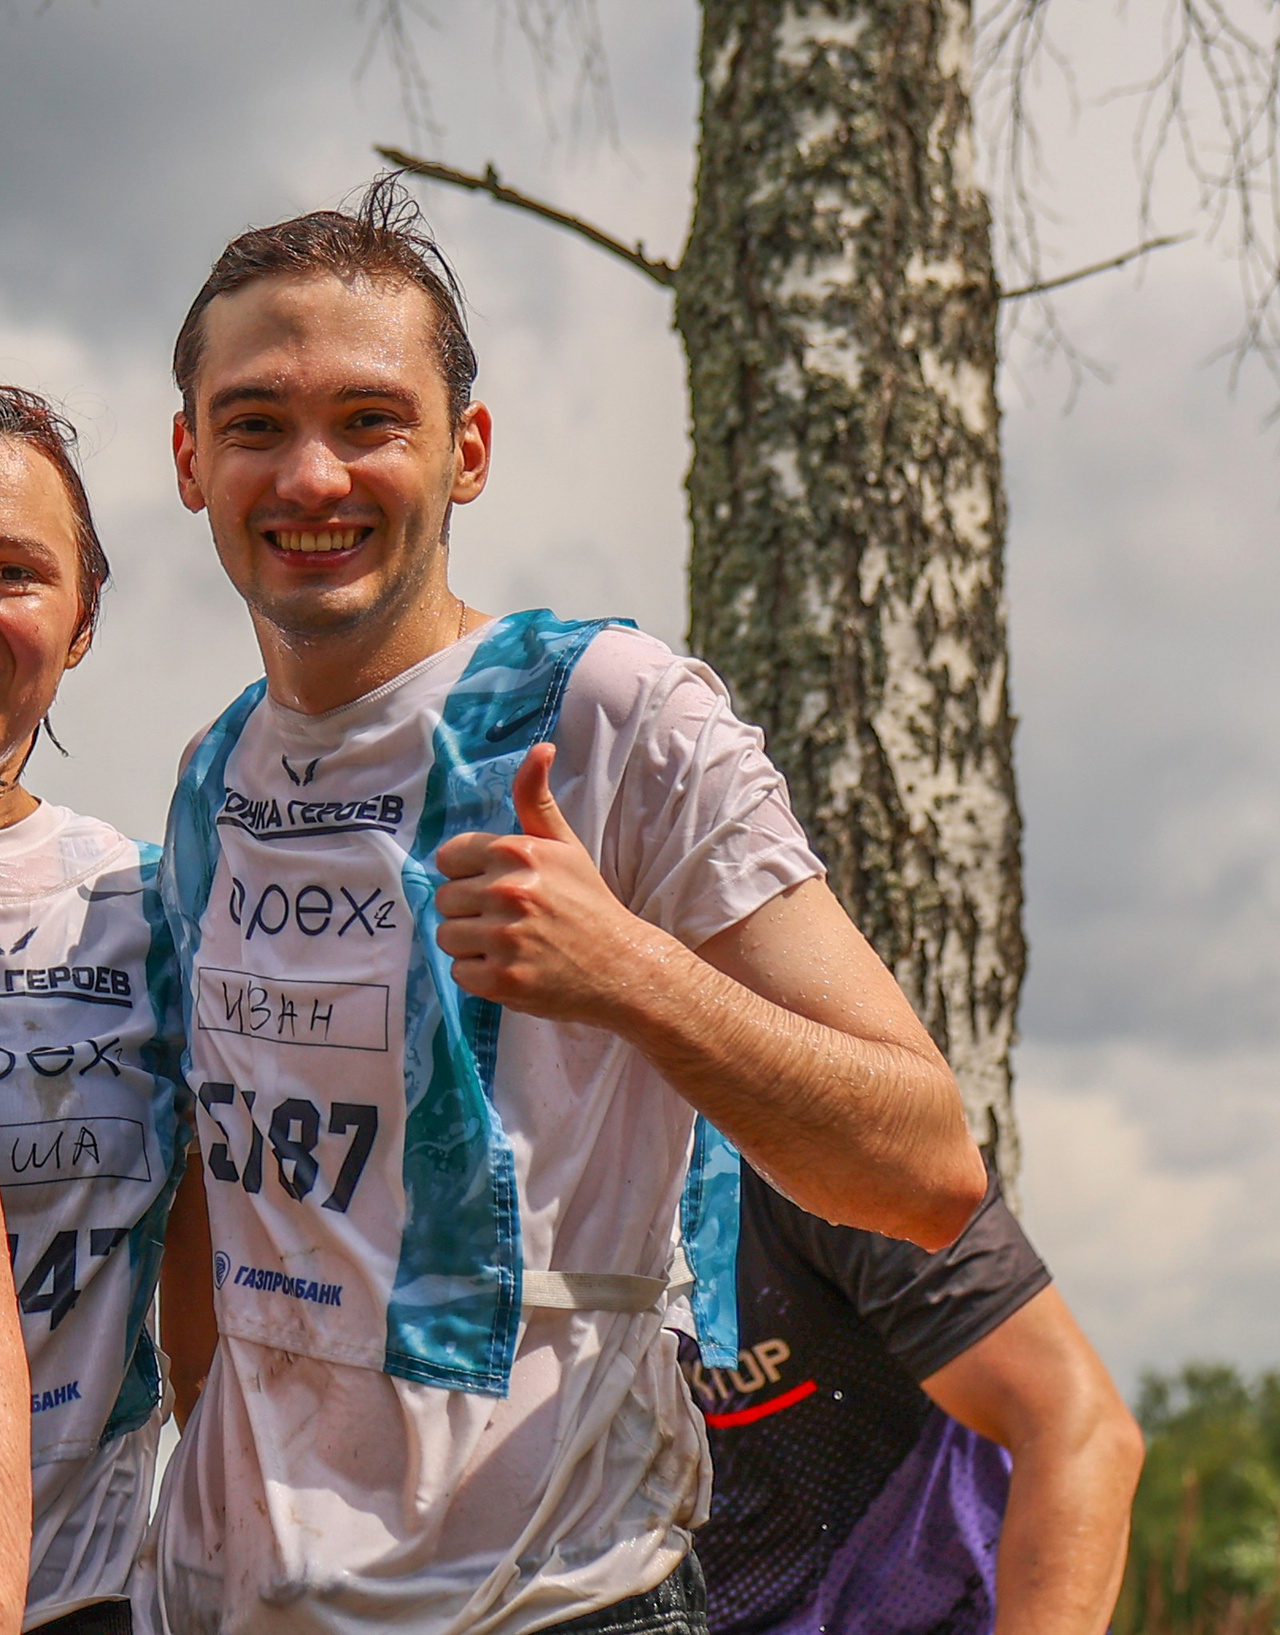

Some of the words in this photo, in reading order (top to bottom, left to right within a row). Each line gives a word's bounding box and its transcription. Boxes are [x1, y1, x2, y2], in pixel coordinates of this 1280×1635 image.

[225, 787, 282, 829] ОНКА
[288, 795, 403, 826] ГЕРОЕВ
[5, 966, 132, 997] ГЕРОЕВ
